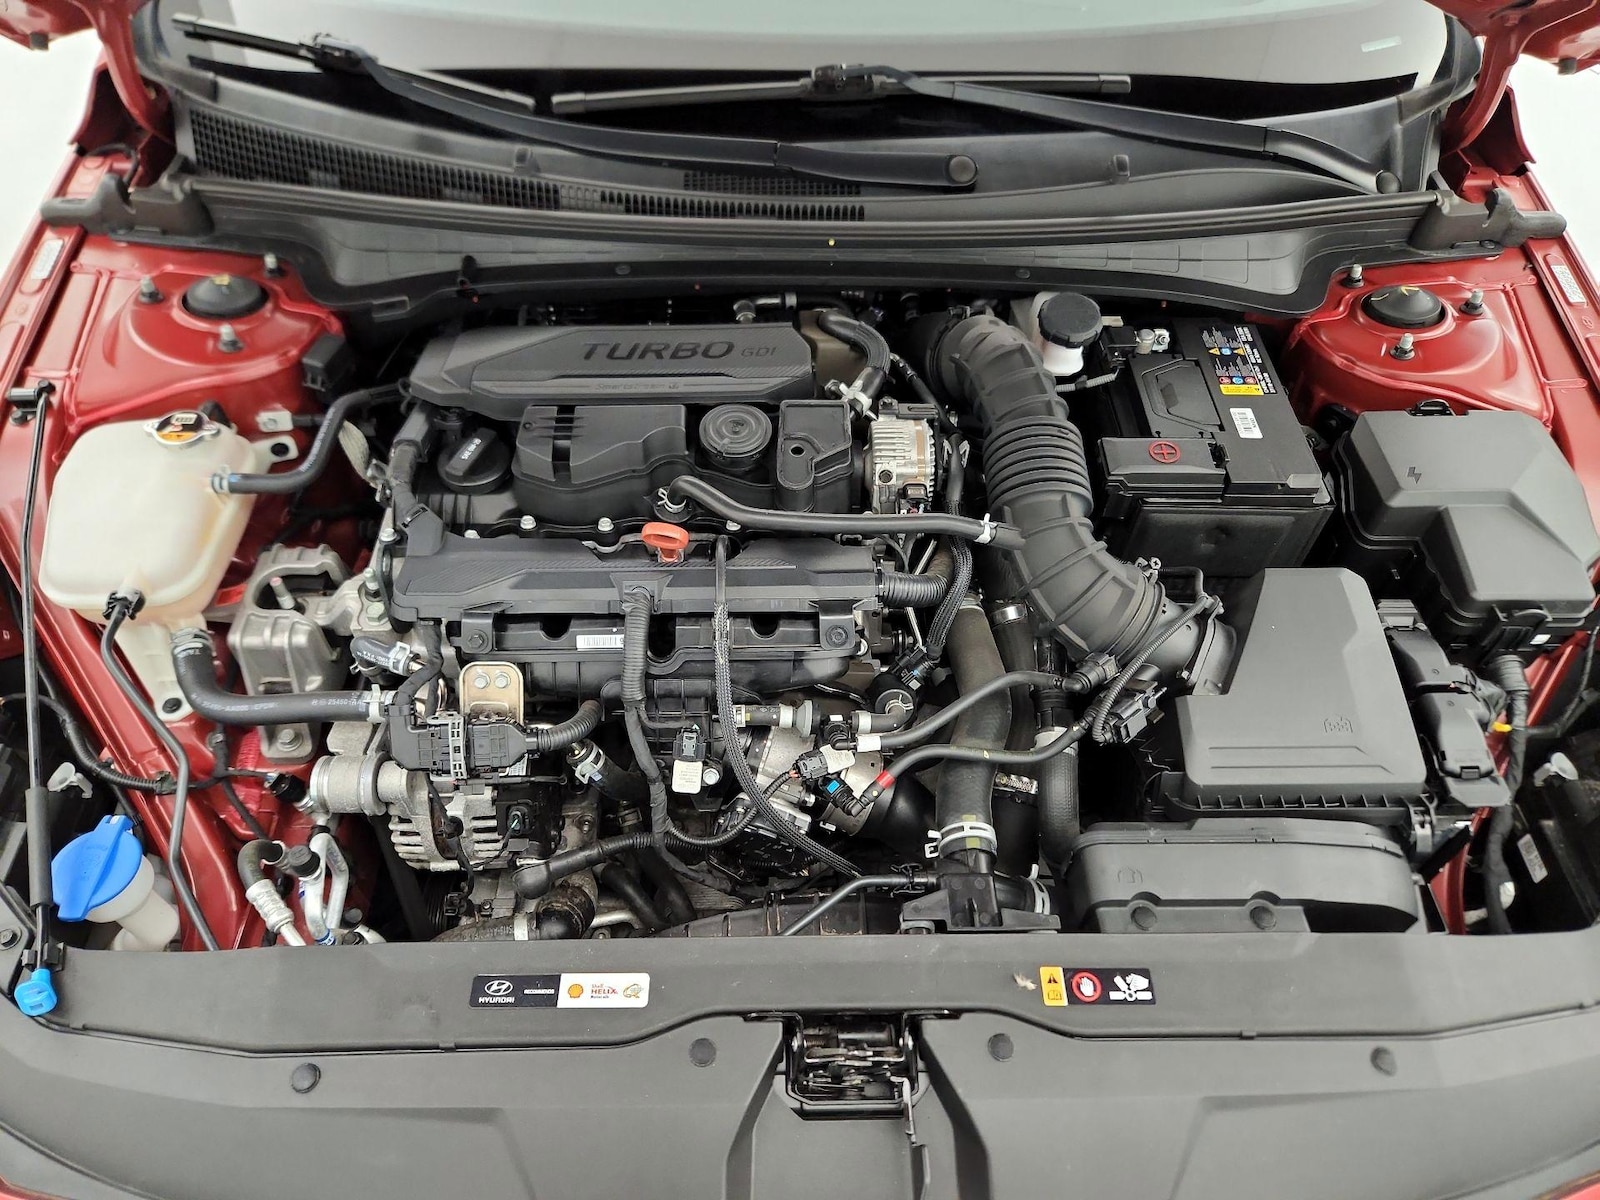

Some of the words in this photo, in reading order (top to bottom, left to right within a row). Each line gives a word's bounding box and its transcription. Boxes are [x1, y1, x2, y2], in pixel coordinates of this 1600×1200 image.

[583, 341, 735, 361] TURBO
[741, 346, 776, 357] GDI
[478, 996, 515, 1004] HYUNDAI
